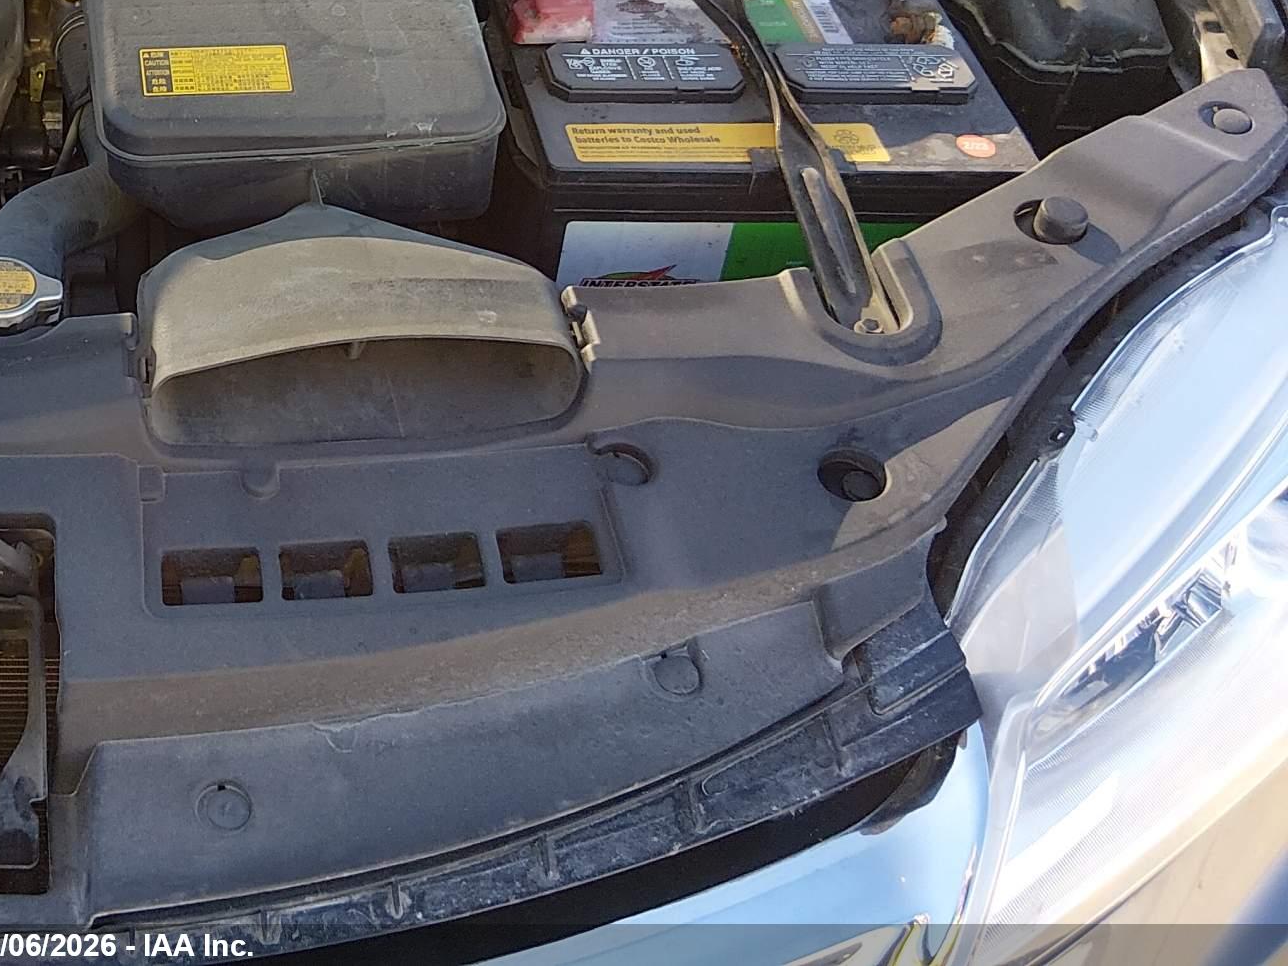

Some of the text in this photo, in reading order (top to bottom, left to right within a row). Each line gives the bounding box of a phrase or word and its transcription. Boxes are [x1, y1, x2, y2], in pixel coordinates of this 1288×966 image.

[572, 126, 701, 136] Return warranty and used
[575, 135, 721, 144] batteries to Costco Wholesale
